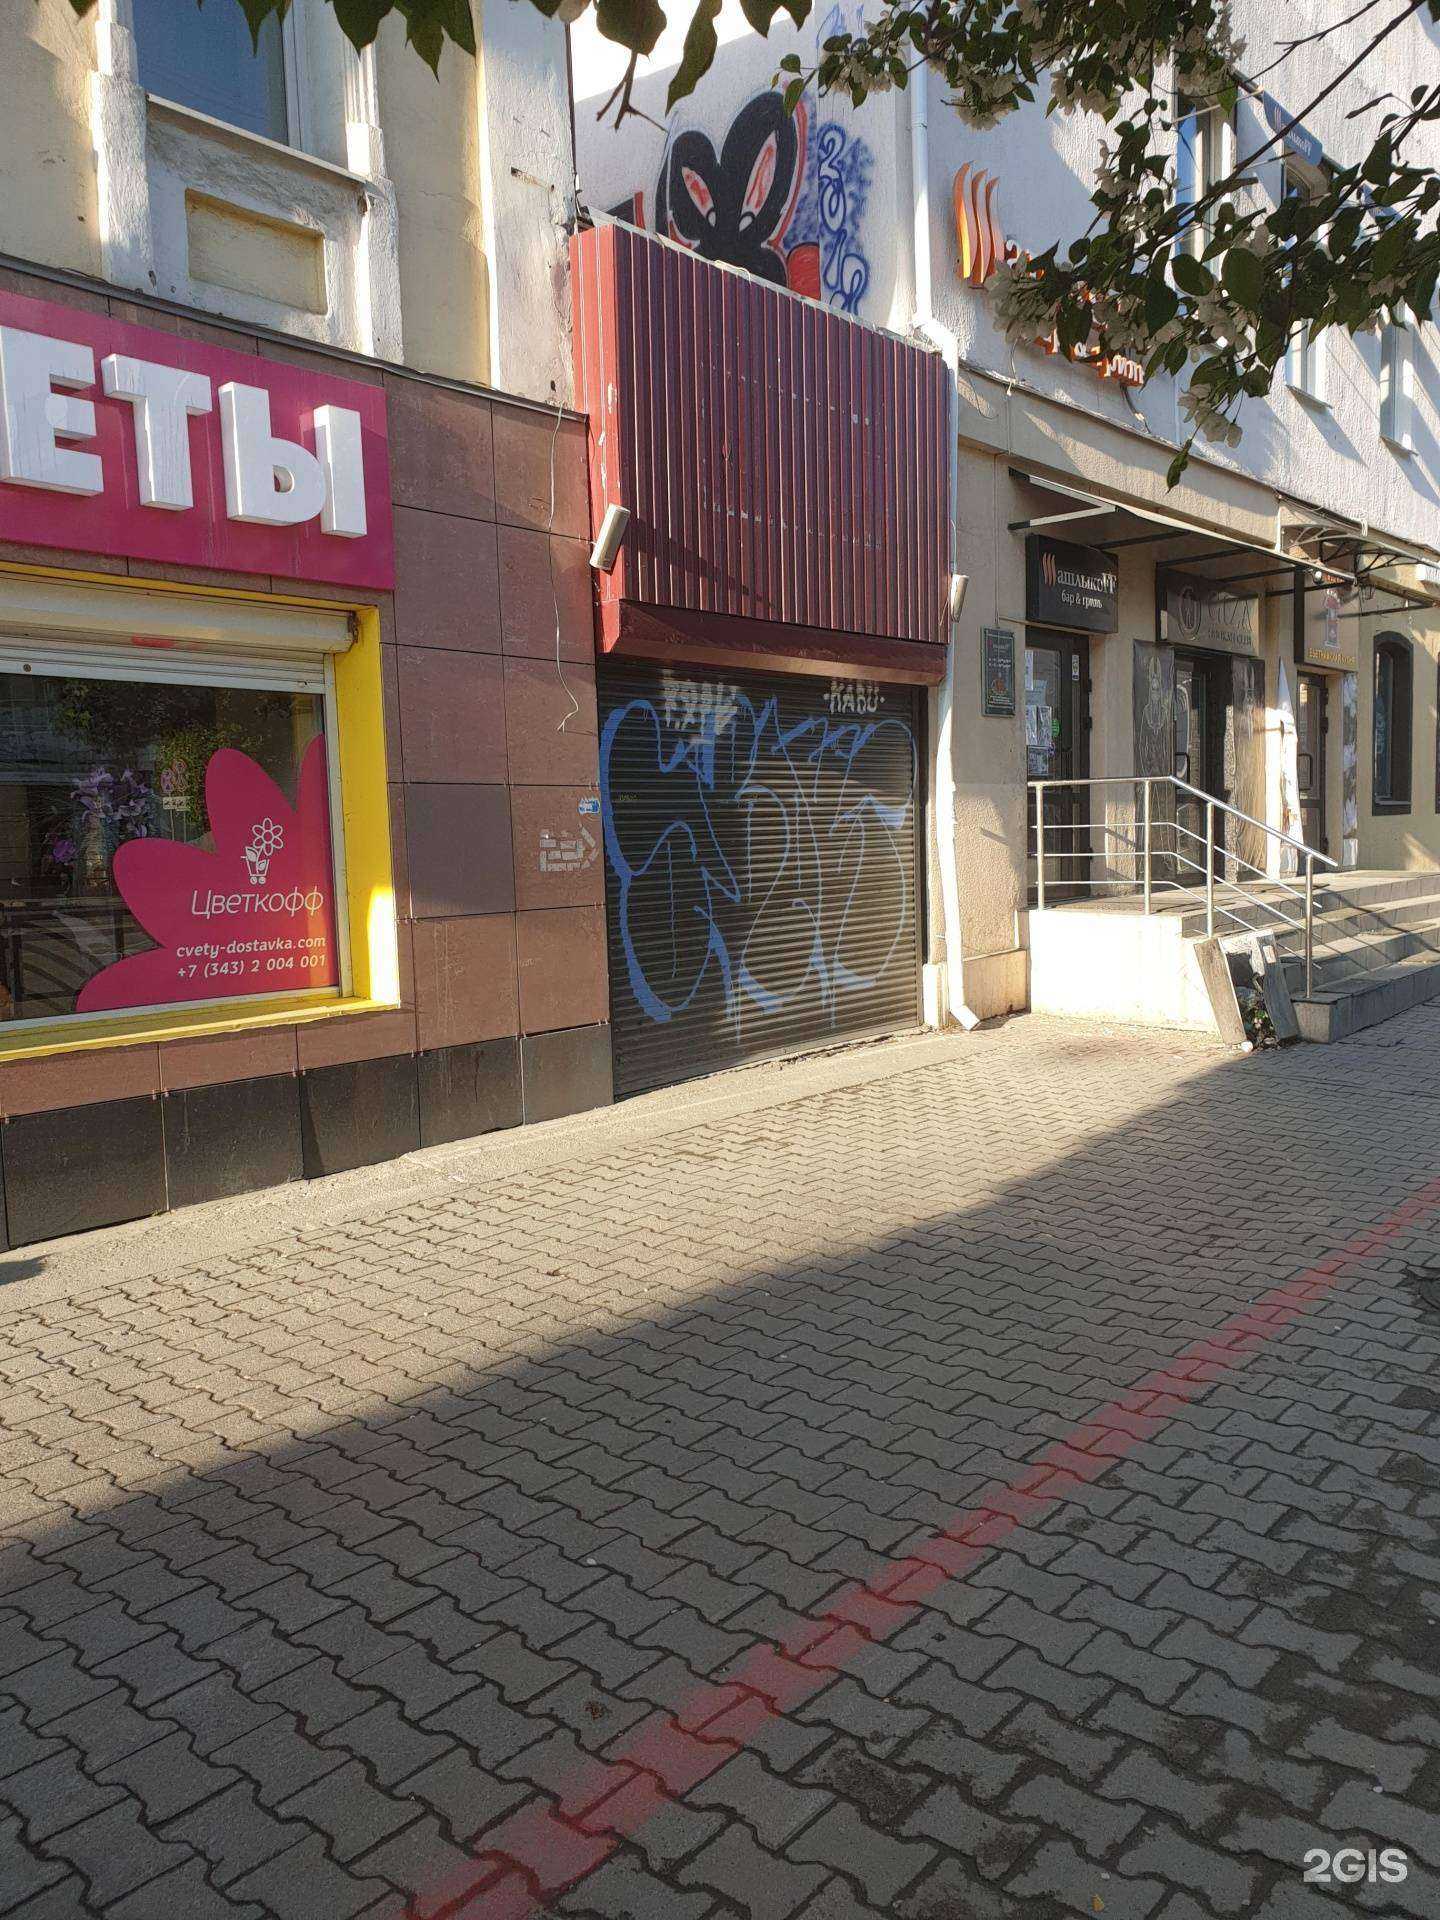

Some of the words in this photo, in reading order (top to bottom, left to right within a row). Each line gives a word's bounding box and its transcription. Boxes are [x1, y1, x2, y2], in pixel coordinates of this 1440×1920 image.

[176, 935, 326, 959] cvety-dostavka.com
[178, 964, 197, 978] +7
[204, 960, 244, 978] (343)
[251, 959, 260, 973] 2
[266, 956, 294, 971] 004
[300, 954, 326, 968] 001
